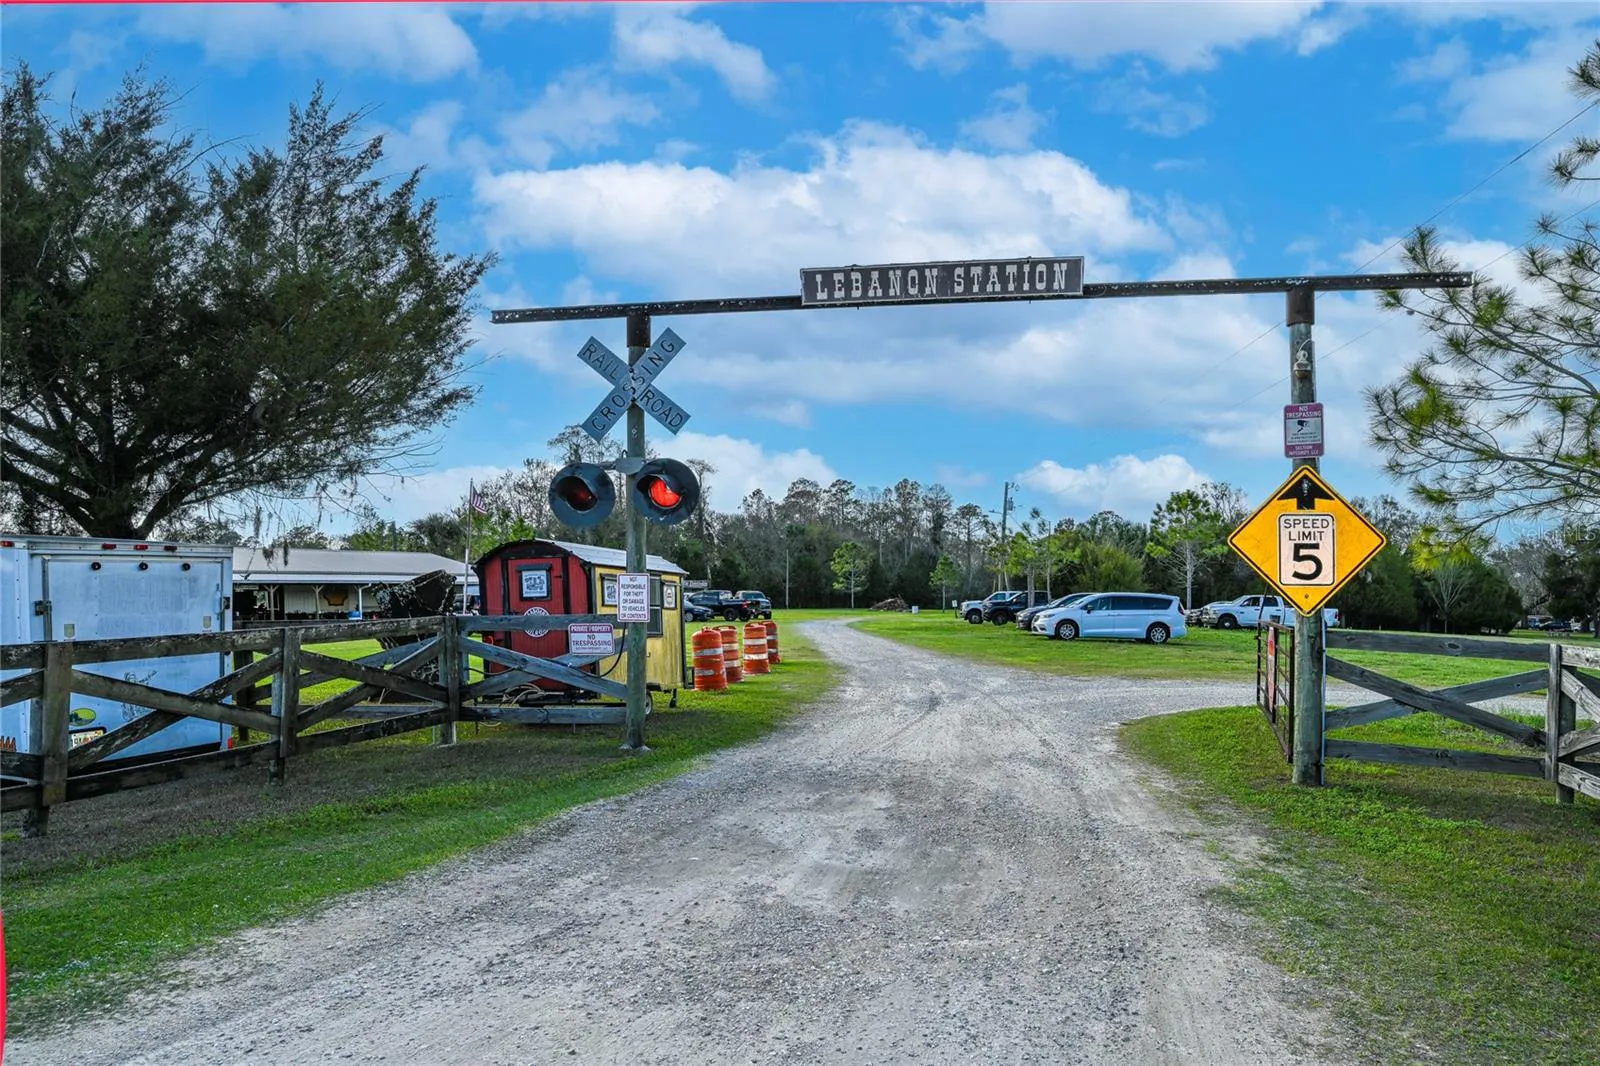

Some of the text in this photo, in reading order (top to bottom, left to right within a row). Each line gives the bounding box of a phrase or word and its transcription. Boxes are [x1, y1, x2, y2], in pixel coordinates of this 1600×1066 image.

[815, 262, 1069, 301] LEBANON STATION
[582, 343, 683, 428] RAIL ROAD
[591, 339, 675, 431] CROSSING
[1286, 410, 1322, 418] TRESPASSING
[1283, 518, 1330, 529] SPEED
[1288, 530, 1325, 541] LIMIT
[1292, 543, 1323, 580] 5
